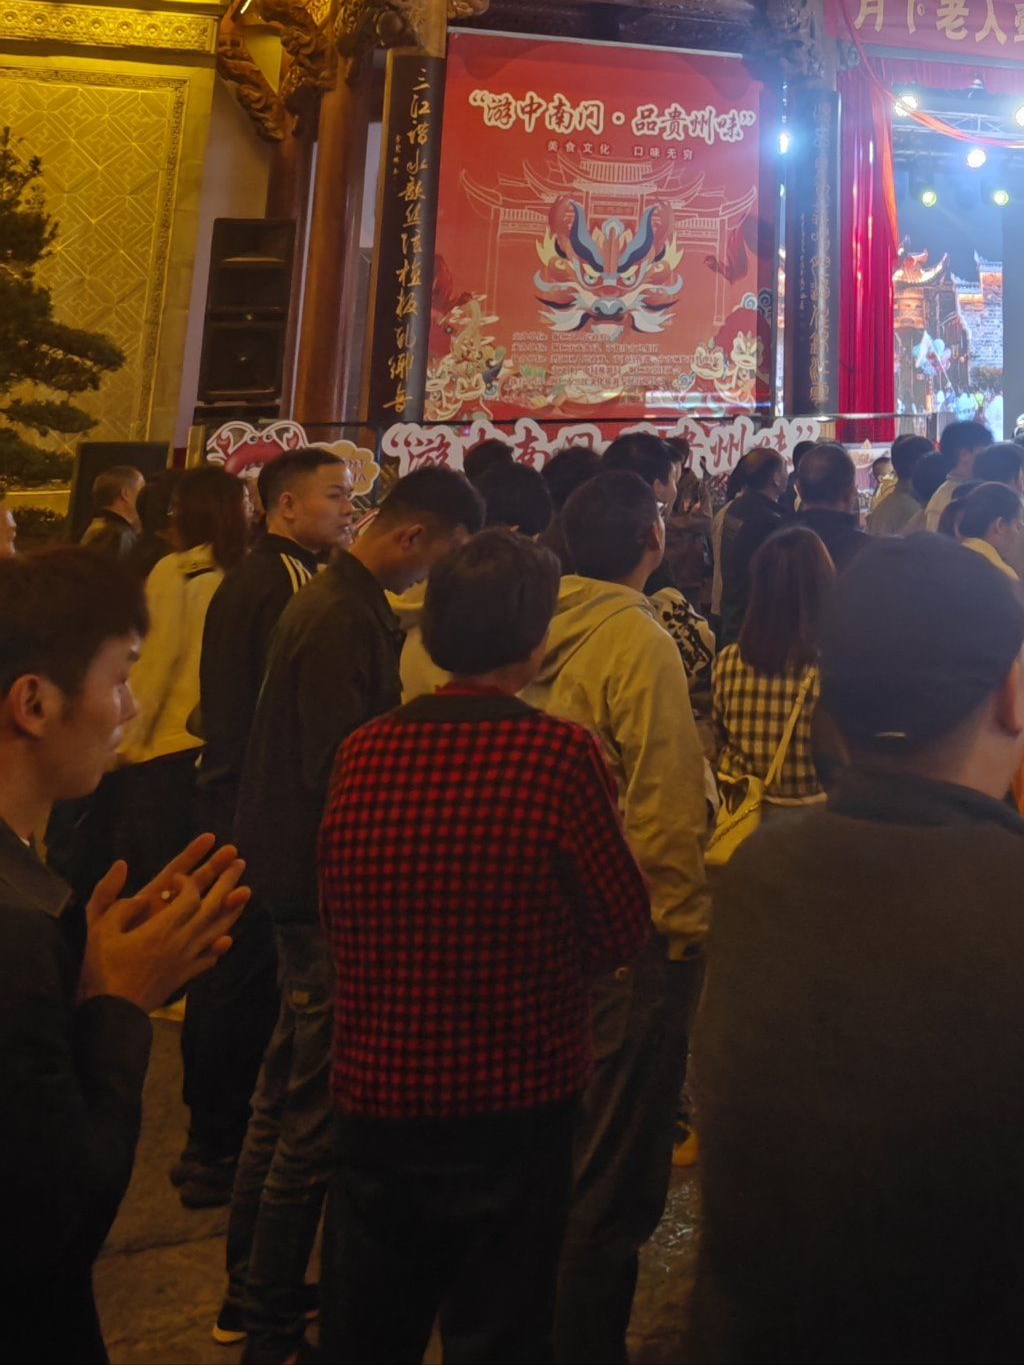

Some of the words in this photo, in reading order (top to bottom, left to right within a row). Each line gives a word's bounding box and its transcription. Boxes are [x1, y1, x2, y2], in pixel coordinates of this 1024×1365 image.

[547, 139, 611, 156] 美食文化
[633, 145, 694, 161] 口味无穷
